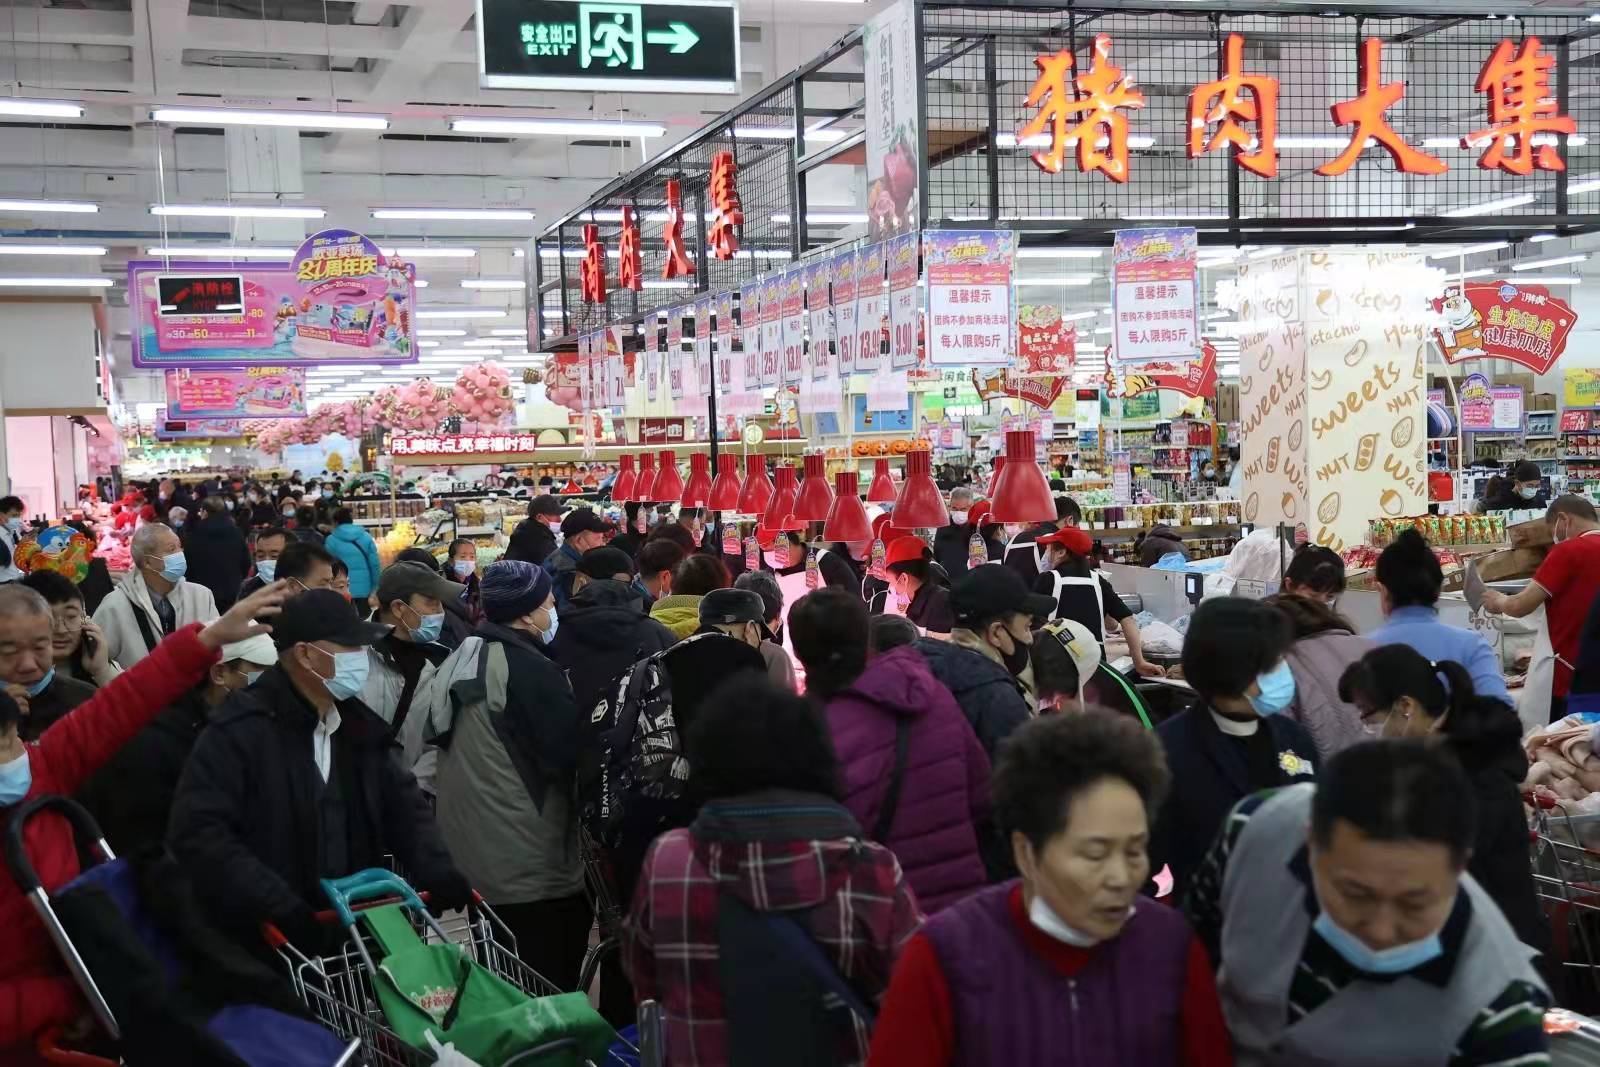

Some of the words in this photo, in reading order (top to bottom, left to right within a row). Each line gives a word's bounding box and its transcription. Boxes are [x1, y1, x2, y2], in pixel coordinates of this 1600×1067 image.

[520, 23, 577, 45] 安全出口
[527, 44, 571, 56] EXIT
[1016, 33, 1576, 183] 猪肉大集
[949, 289, 992, 304] 温馨提示
[1135, 285, 1178, 299] 温馨提示
[934, 314, 1008, 326] 团购不参加商场活动
[941, 334, 1001, 349] 每人限购5斤
[1128, 328, 1188, 344] 每人限购5斤
[1483, 325, 1553, 360] 健康肌肤
[1311, 361, 1400, 440] sweets
[1386, 385, 1420, 414] NUT
[391, 436, 536, 454] 用美味点亮幸福时刻
[1316, 452, 1350, 482] NUT
